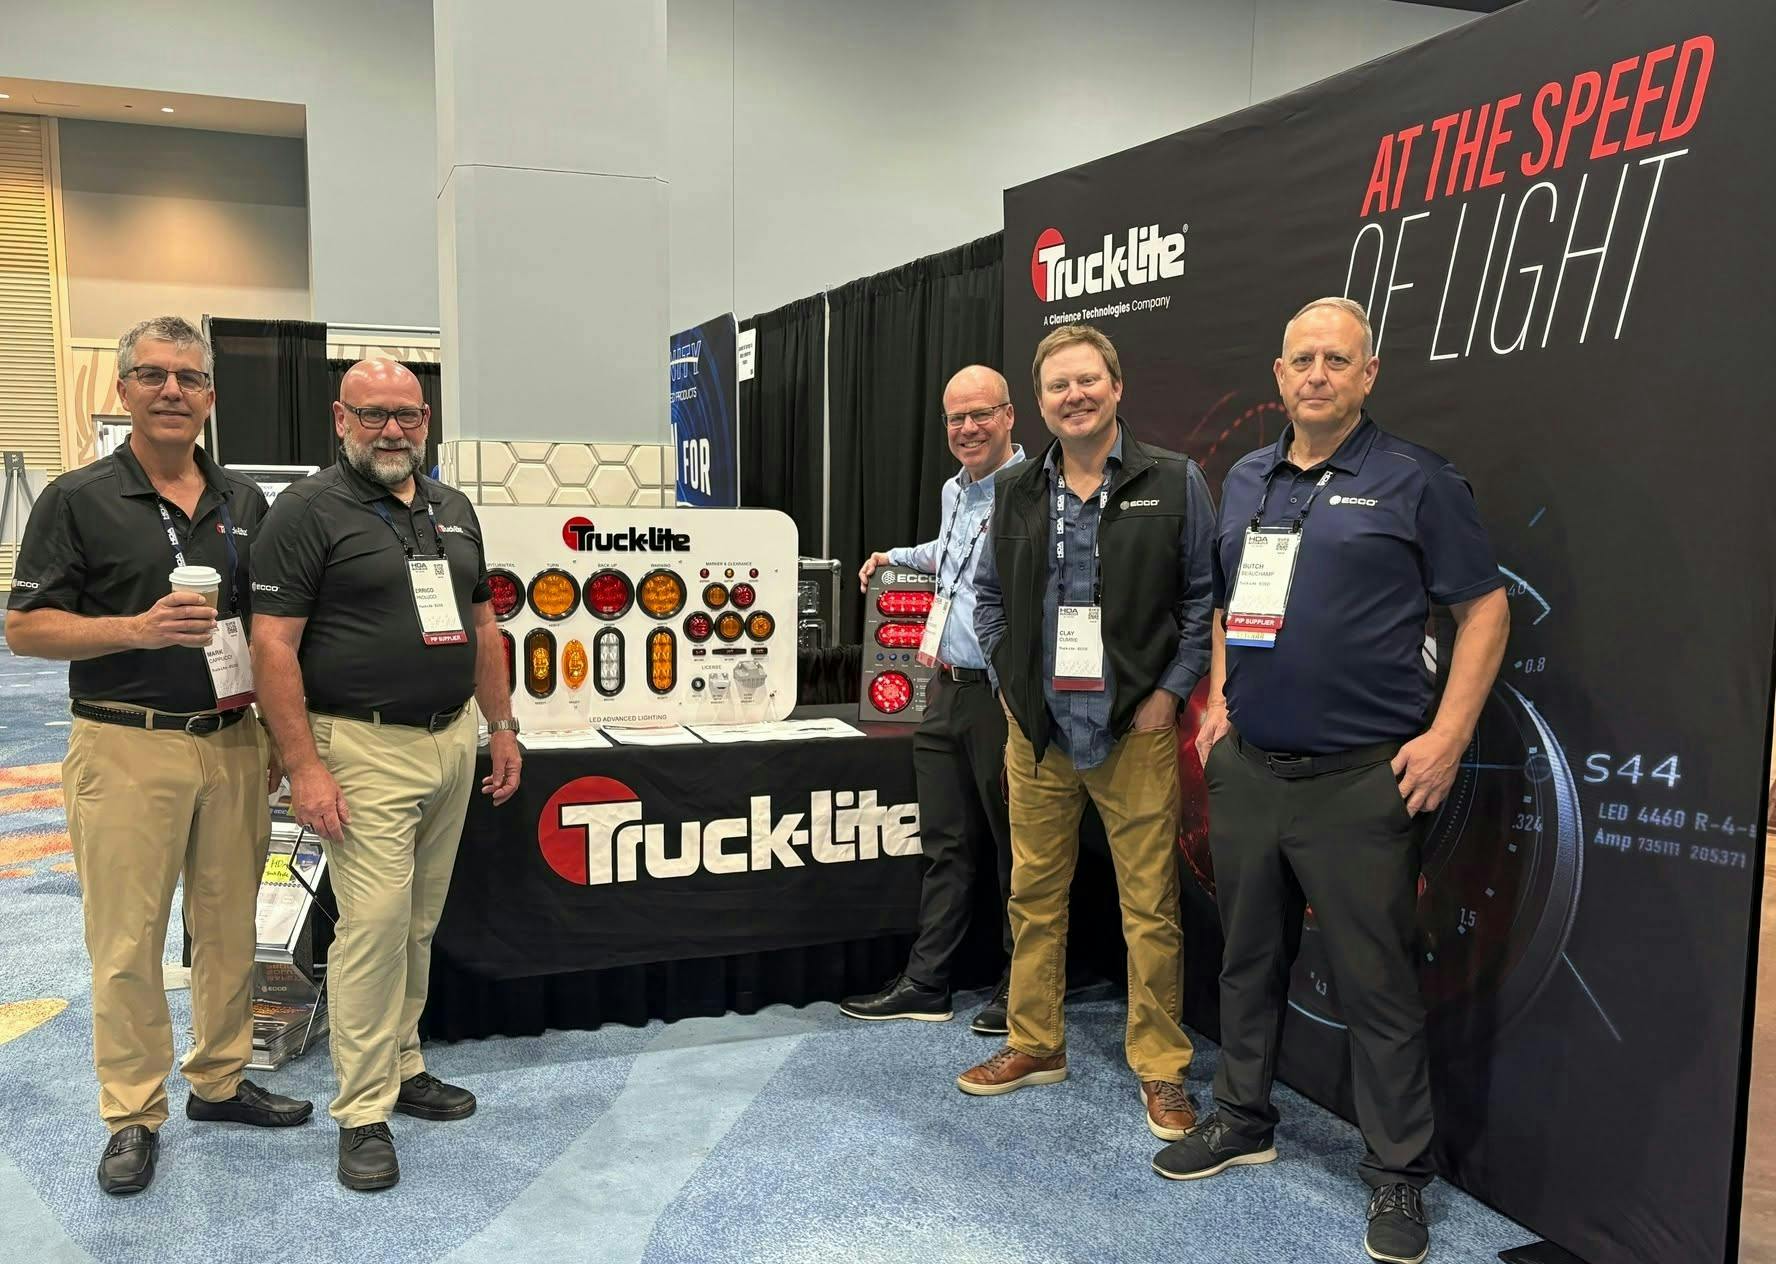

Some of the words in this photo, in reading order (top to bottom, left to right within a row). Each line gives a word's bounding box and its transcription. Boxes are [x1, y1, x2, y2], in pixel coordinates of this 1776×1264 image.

[1360, 124, 1424, 217] AT
[1424, 93, 1522, 202] THE
[1520, 35, 1715, 178] SPEED
[1343, 211, 1430, 357] OF
[1430, 149, 1689, 361] LIGHT
[1043, 316, 1049, 326] A
[1049, 311, 1081, 326] Clarience
[1082, 302, 1130, 320] Technologies
[1131, 296, 1171, 312] Company
[676, 386, 698, 402] PRODUCTS
[683, 438, 711, 496] FOR
[1341, 496, 1376, 507] ECCO
[1246, 617, 1275, 626] SUPPLIER
[206, 649, 224, 657] MARK
[1524, 656, 1546, 673] 0.8
[602, 715, 637, 723] ADVANCED
[637, 714, 668, 722] LIGHTING
[1583, 753, 1682, 788] S44
[1598, 802, 1629, 822] LED
[1637, 806, 1686, 829] 4460
[1593, 827, 1632, 852] Amp
